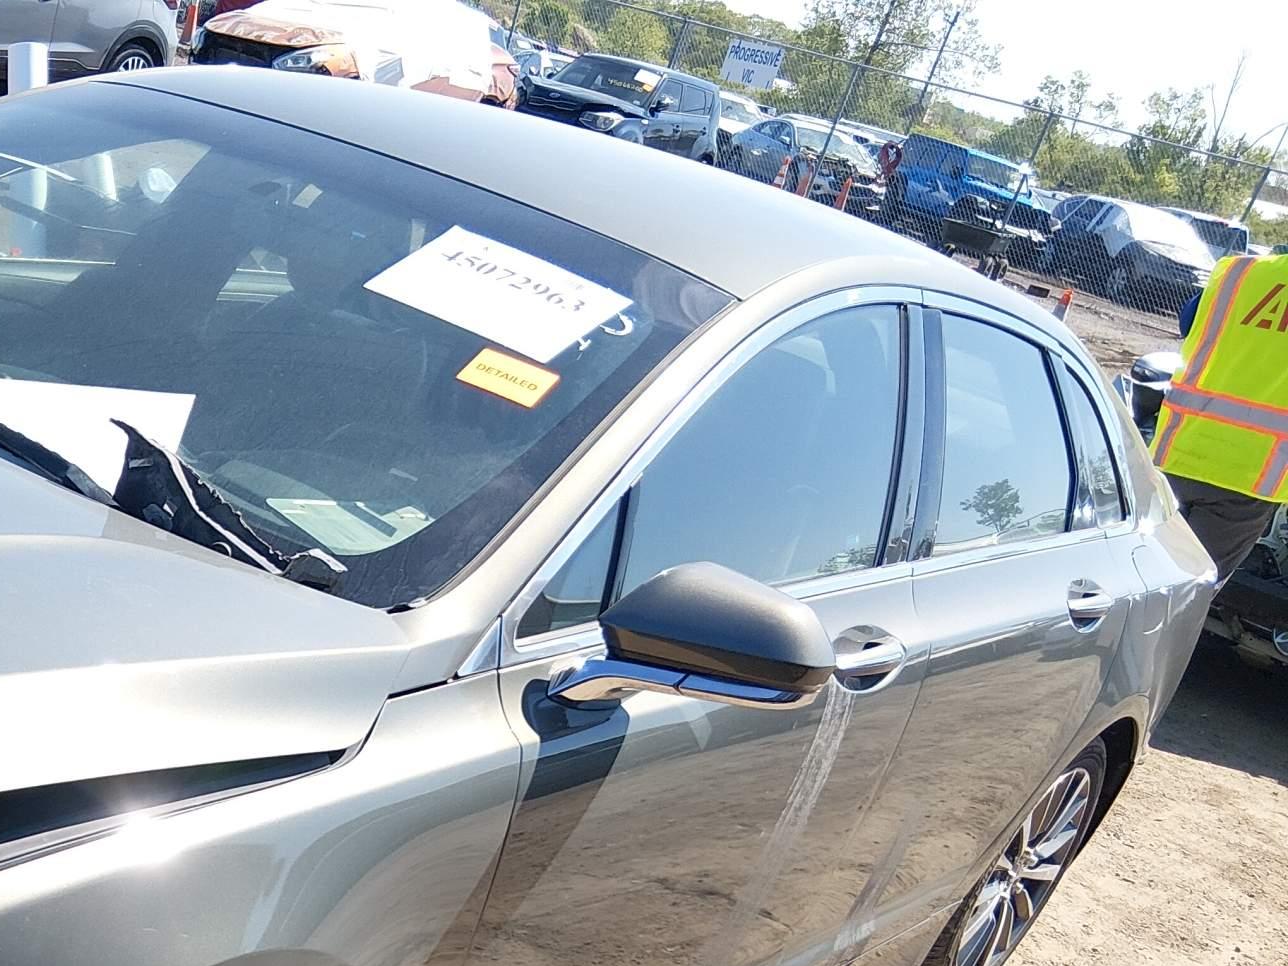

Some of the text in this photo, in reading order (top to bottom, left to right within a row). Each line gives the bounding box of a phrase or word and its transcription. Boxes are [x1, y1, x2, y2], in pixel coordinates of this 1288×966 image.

[728, 45, 782, 67] PROGRESSIVE
[741, 68, 754, 83] VIC
[441, 250, 586, 312] 45072963
[476, 362, 538, 392] DETAILED
